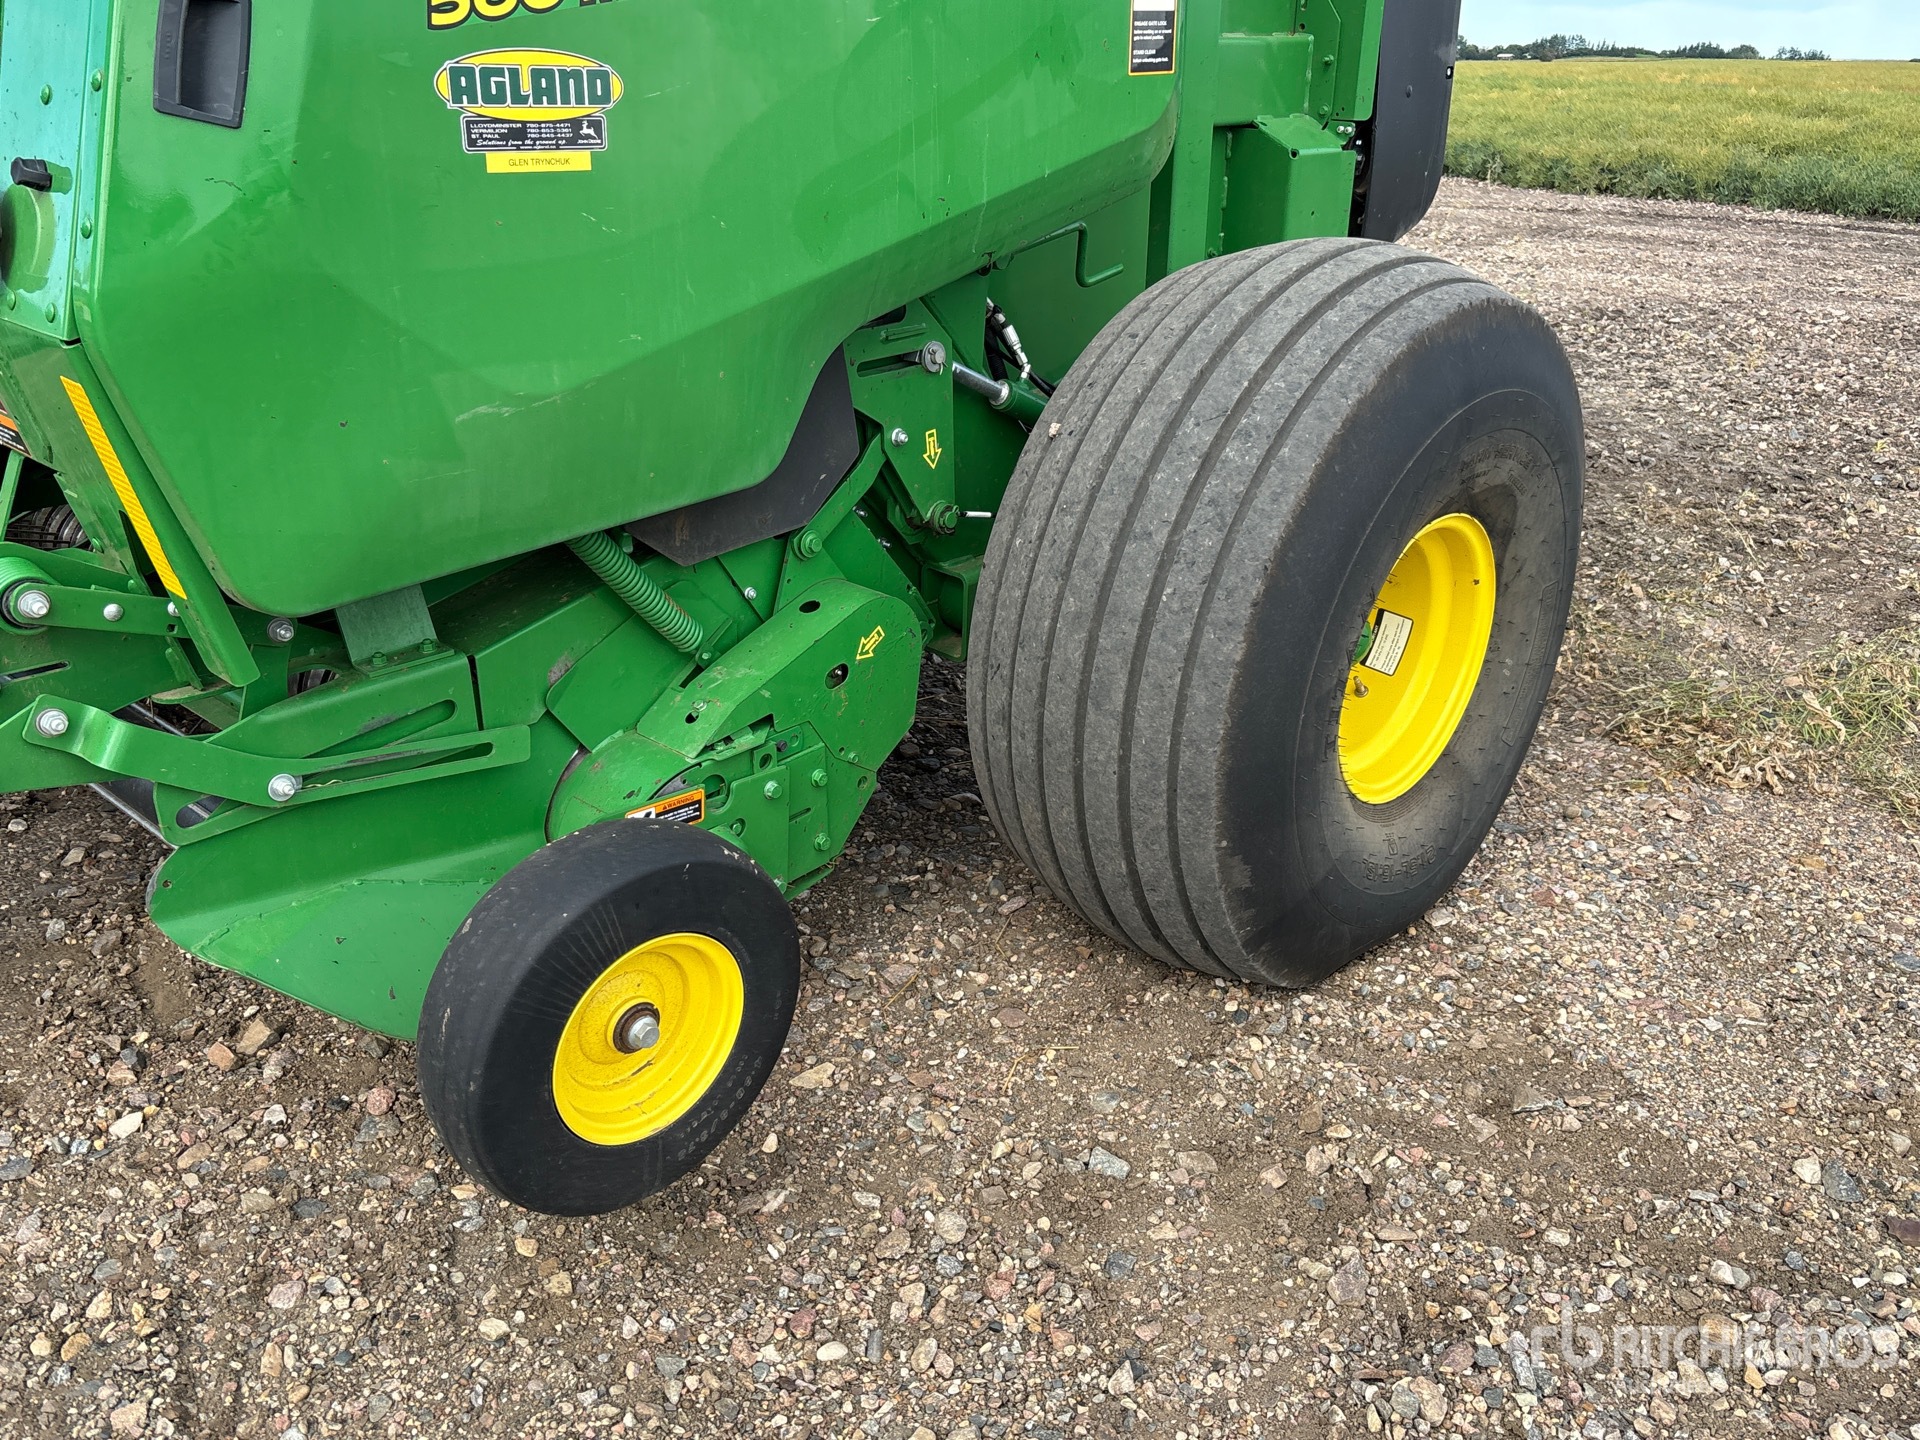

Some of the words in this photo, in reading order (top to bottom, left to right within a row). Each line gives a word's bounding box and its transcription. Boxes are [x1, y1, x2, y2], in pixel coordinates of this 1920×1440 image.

[449, 65, 613, 106] AGLAND
[507, 139, 523, 147] from
[535, 138, 557, 146] ground
[508, 158, 529, 167] GLEN
[530, 157, 571, 166] TRYNCHUK
[666, 795, 695, 809] WARNING
